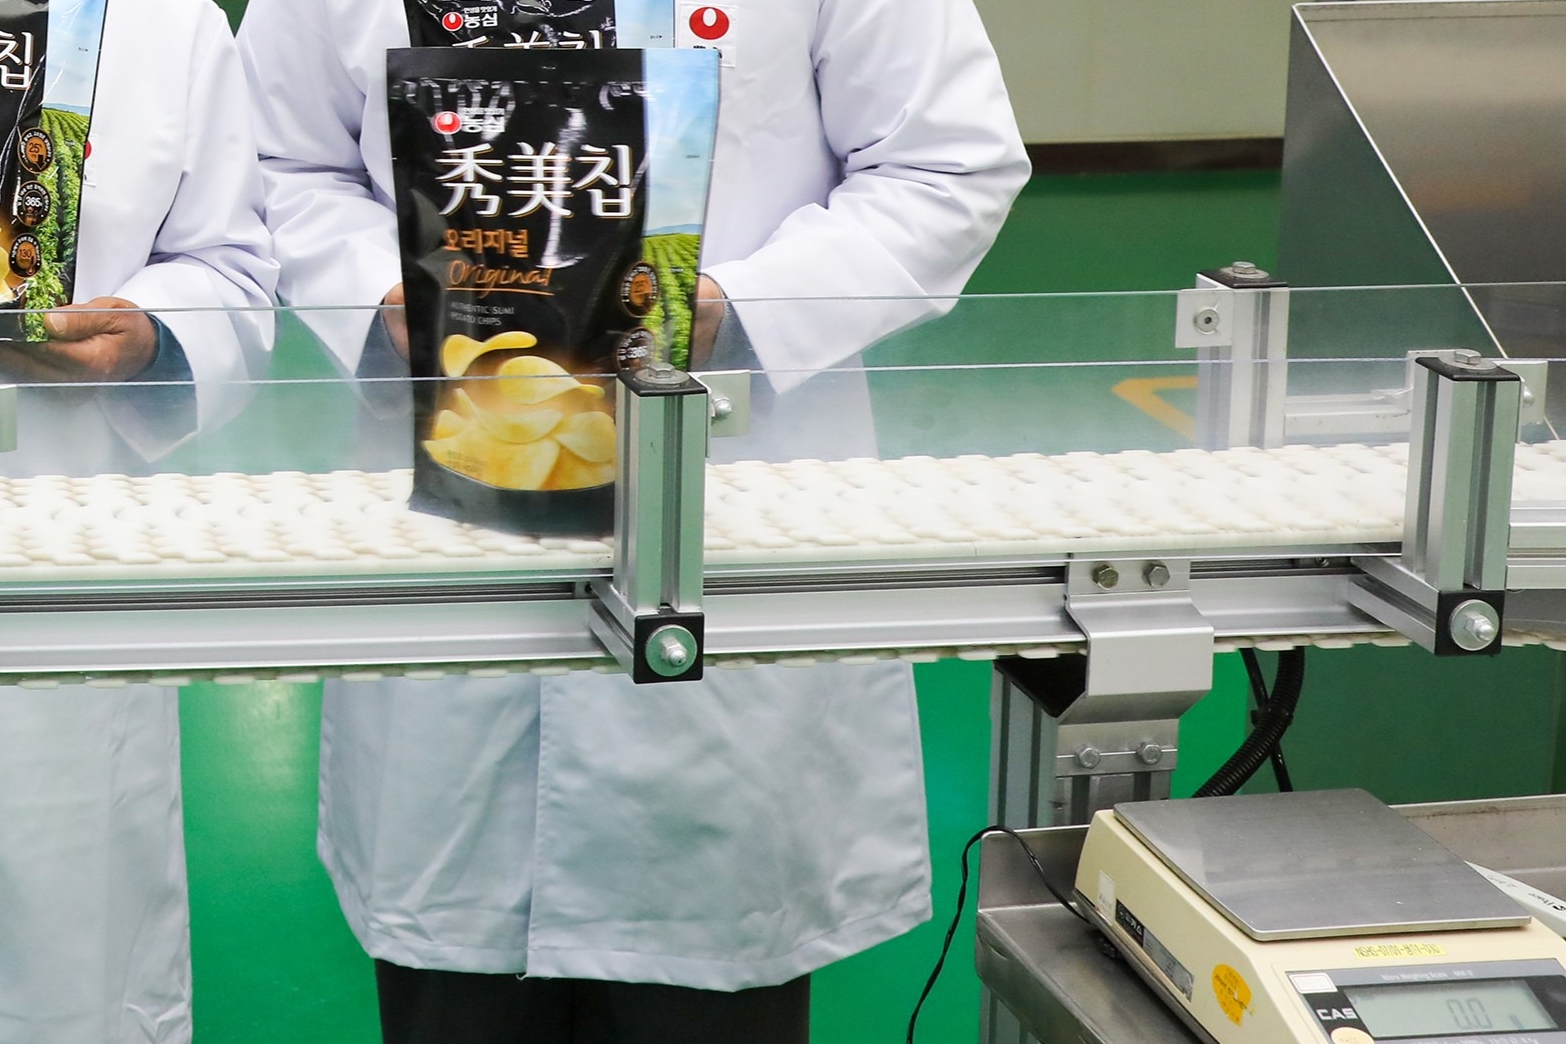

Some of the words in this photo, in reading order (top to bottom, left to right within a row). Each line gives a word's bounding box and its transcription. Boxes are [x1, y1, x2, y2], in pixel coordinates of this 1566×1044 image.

[464, 13, 498, 28] 농심
[434, 141, 634, 219] 秀美칩
[444, 228, 529, 258] 오리지널
[449, 260, 552, 298] Original
[1316, 1008, 1358, 1021] CAS
